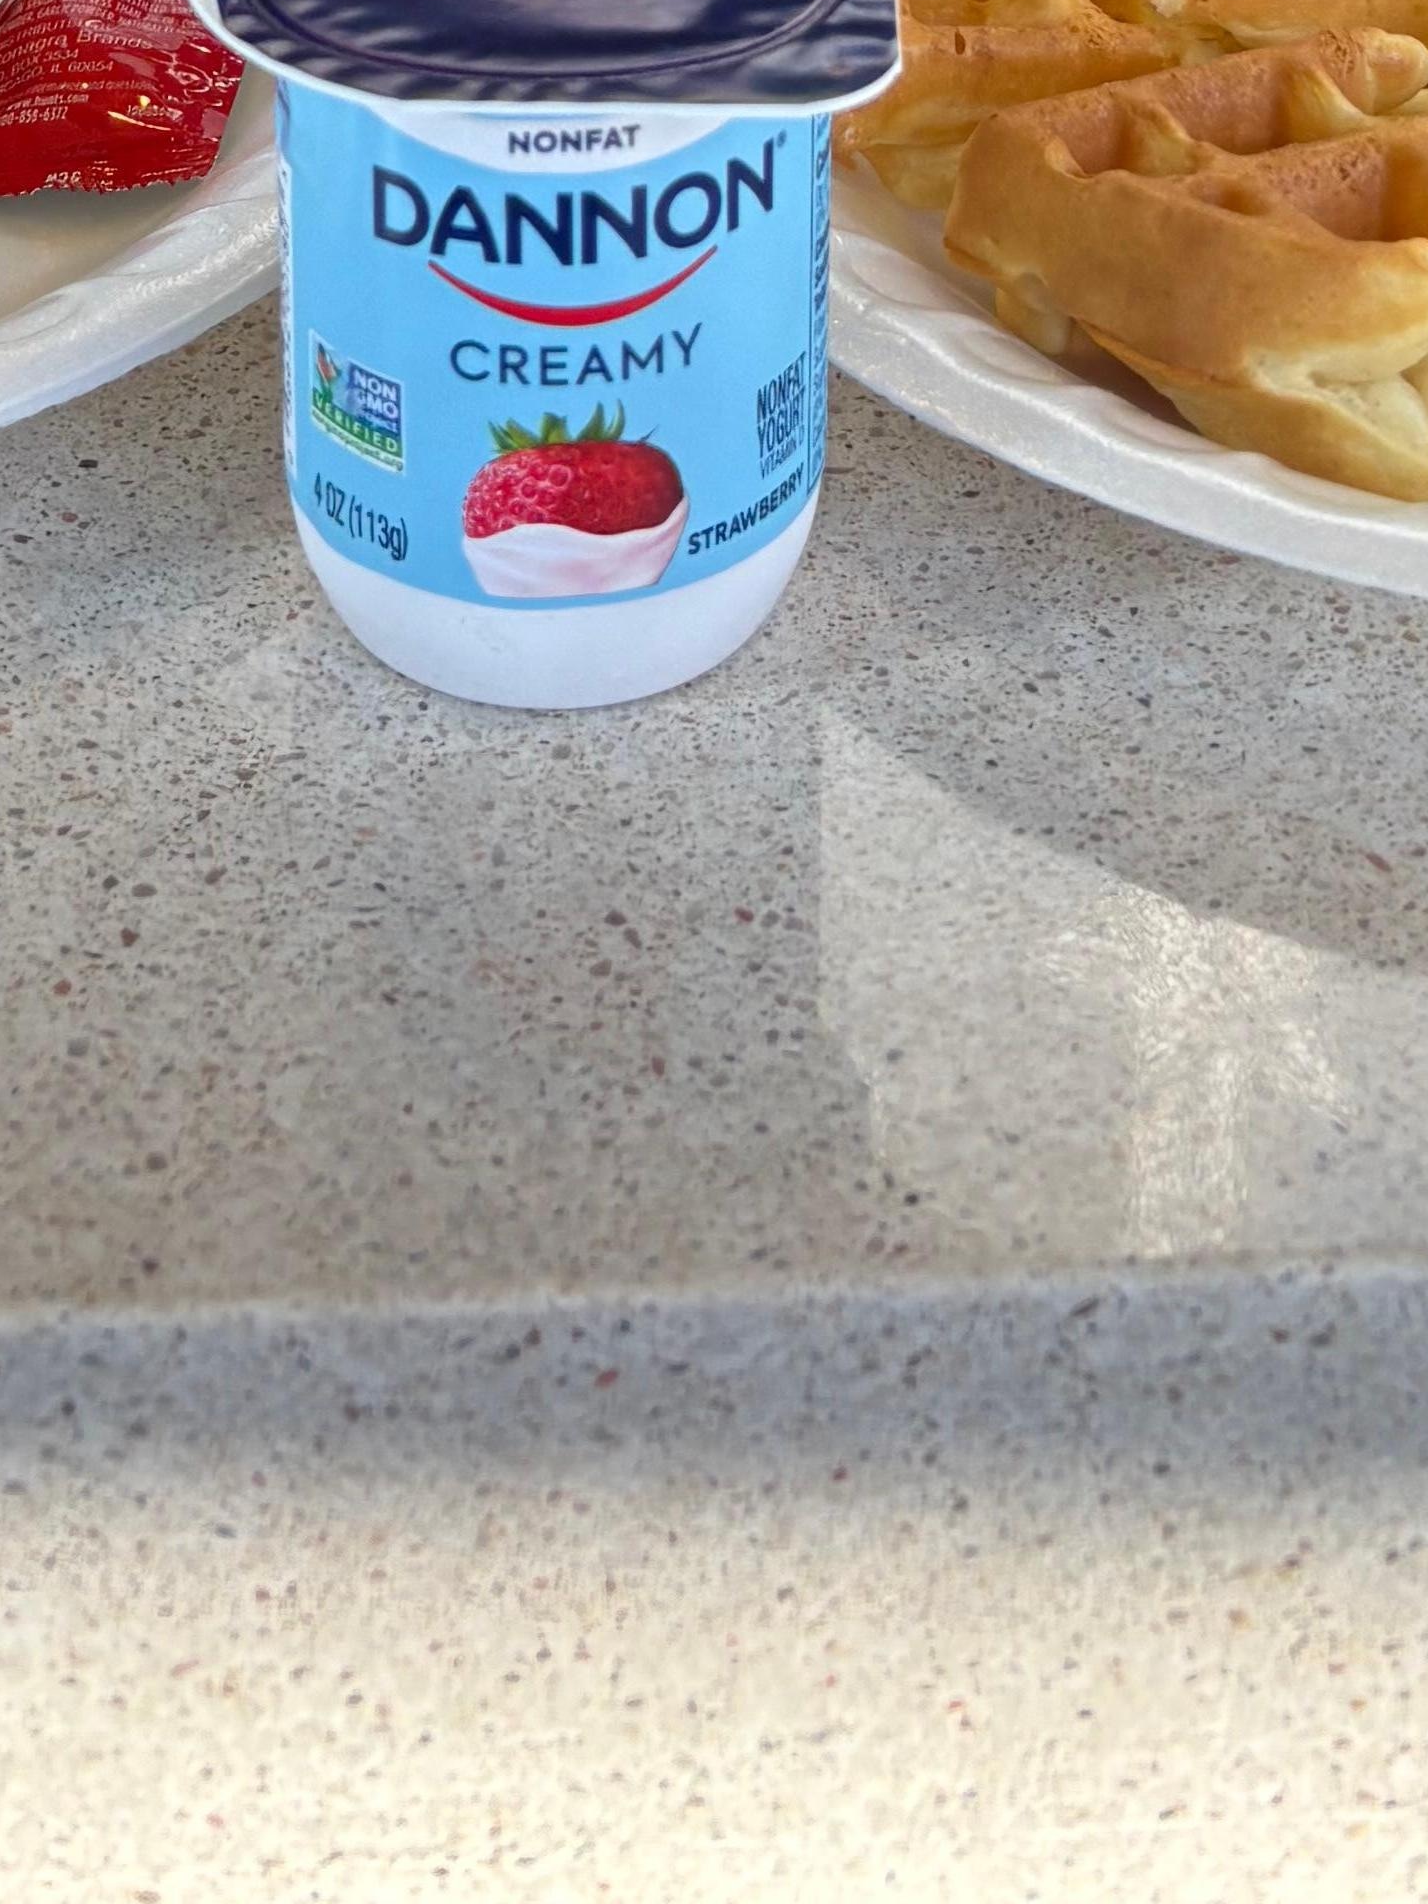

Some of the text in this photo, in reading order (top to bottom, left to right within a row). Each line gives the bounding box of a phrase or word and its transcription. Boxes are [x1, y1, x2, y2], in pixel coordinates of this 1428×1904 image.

[507, 123, 640, 155] NONFAT
[372, 137, 774, 267] DANNON
[352, 367, 398, 402] NON
[449, 322, 703, 387] CREAMY
[756, 350, 806, 424] NONFAT
[314, 391, 399, 453] VERIFIED
[756, 386, 806, 459] YOGURT
[314, 471, 409, 561] 4 OZ (113g)
[687, 462, 805, 556] STRAWBERRY
